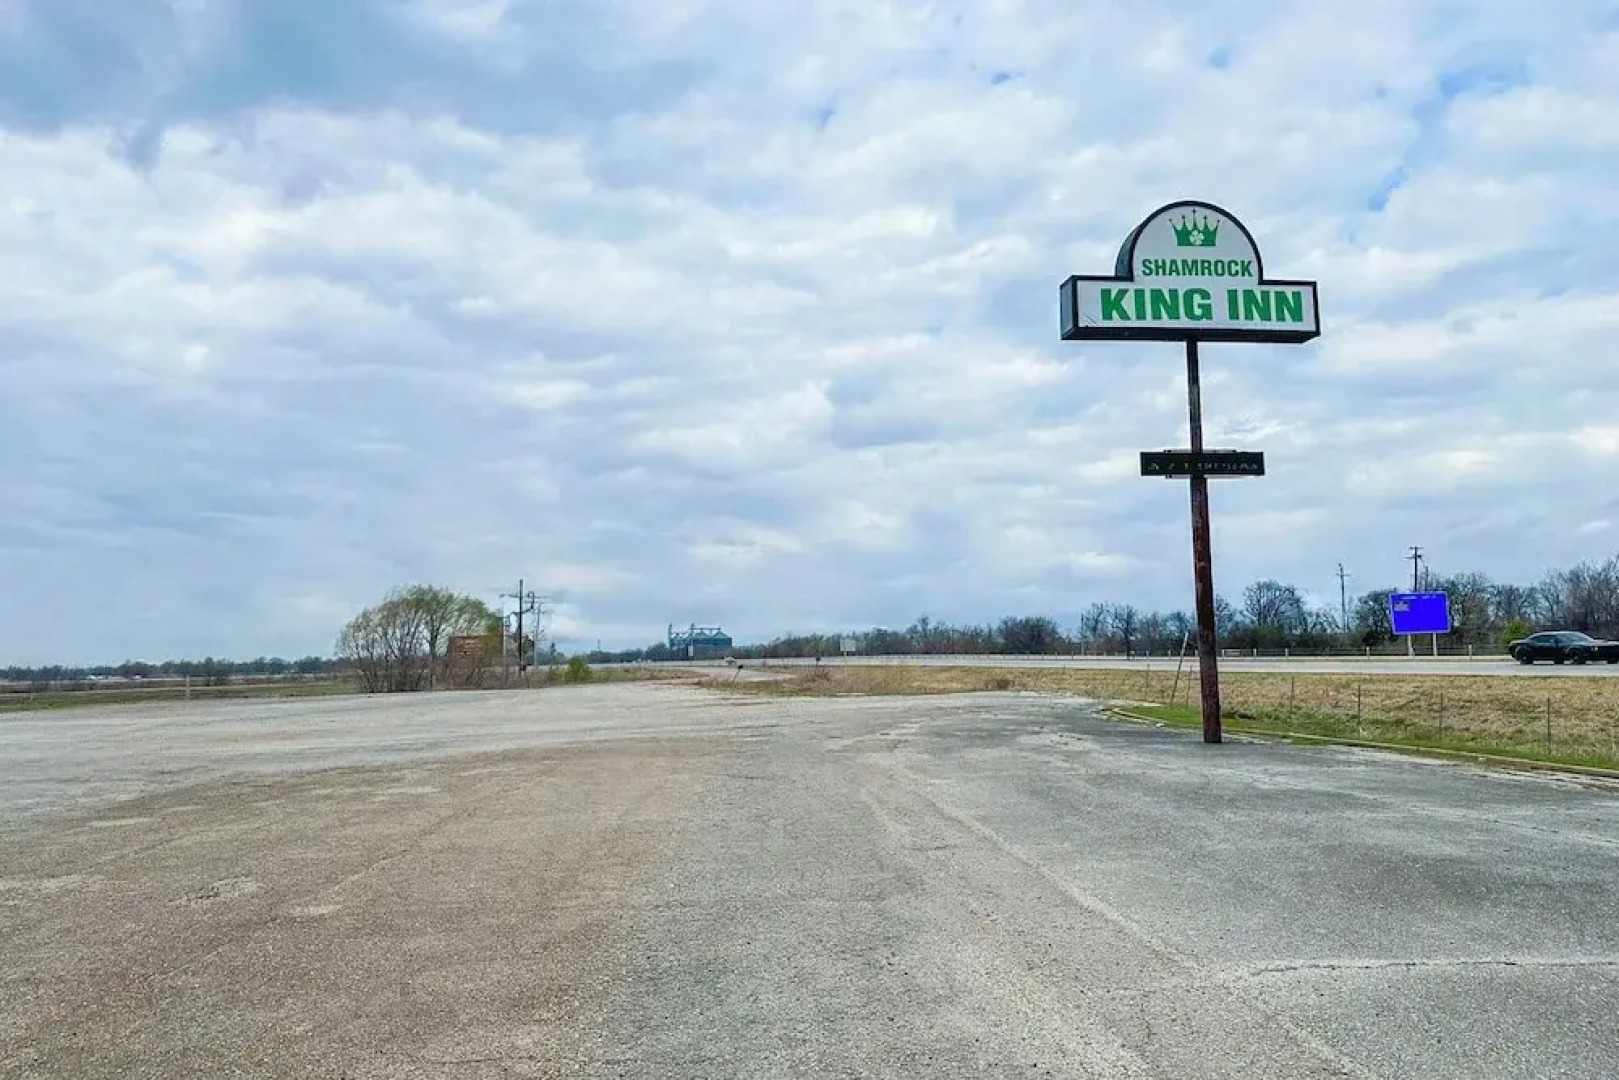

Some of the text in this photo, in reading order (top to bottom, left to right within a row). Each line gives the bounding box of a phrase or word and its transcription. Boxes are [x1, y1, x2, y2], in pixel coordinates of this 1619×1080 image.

[1142, 258, 1254, 278] SHAMROCK
[1100, 287, 1304, 323] KING INN
